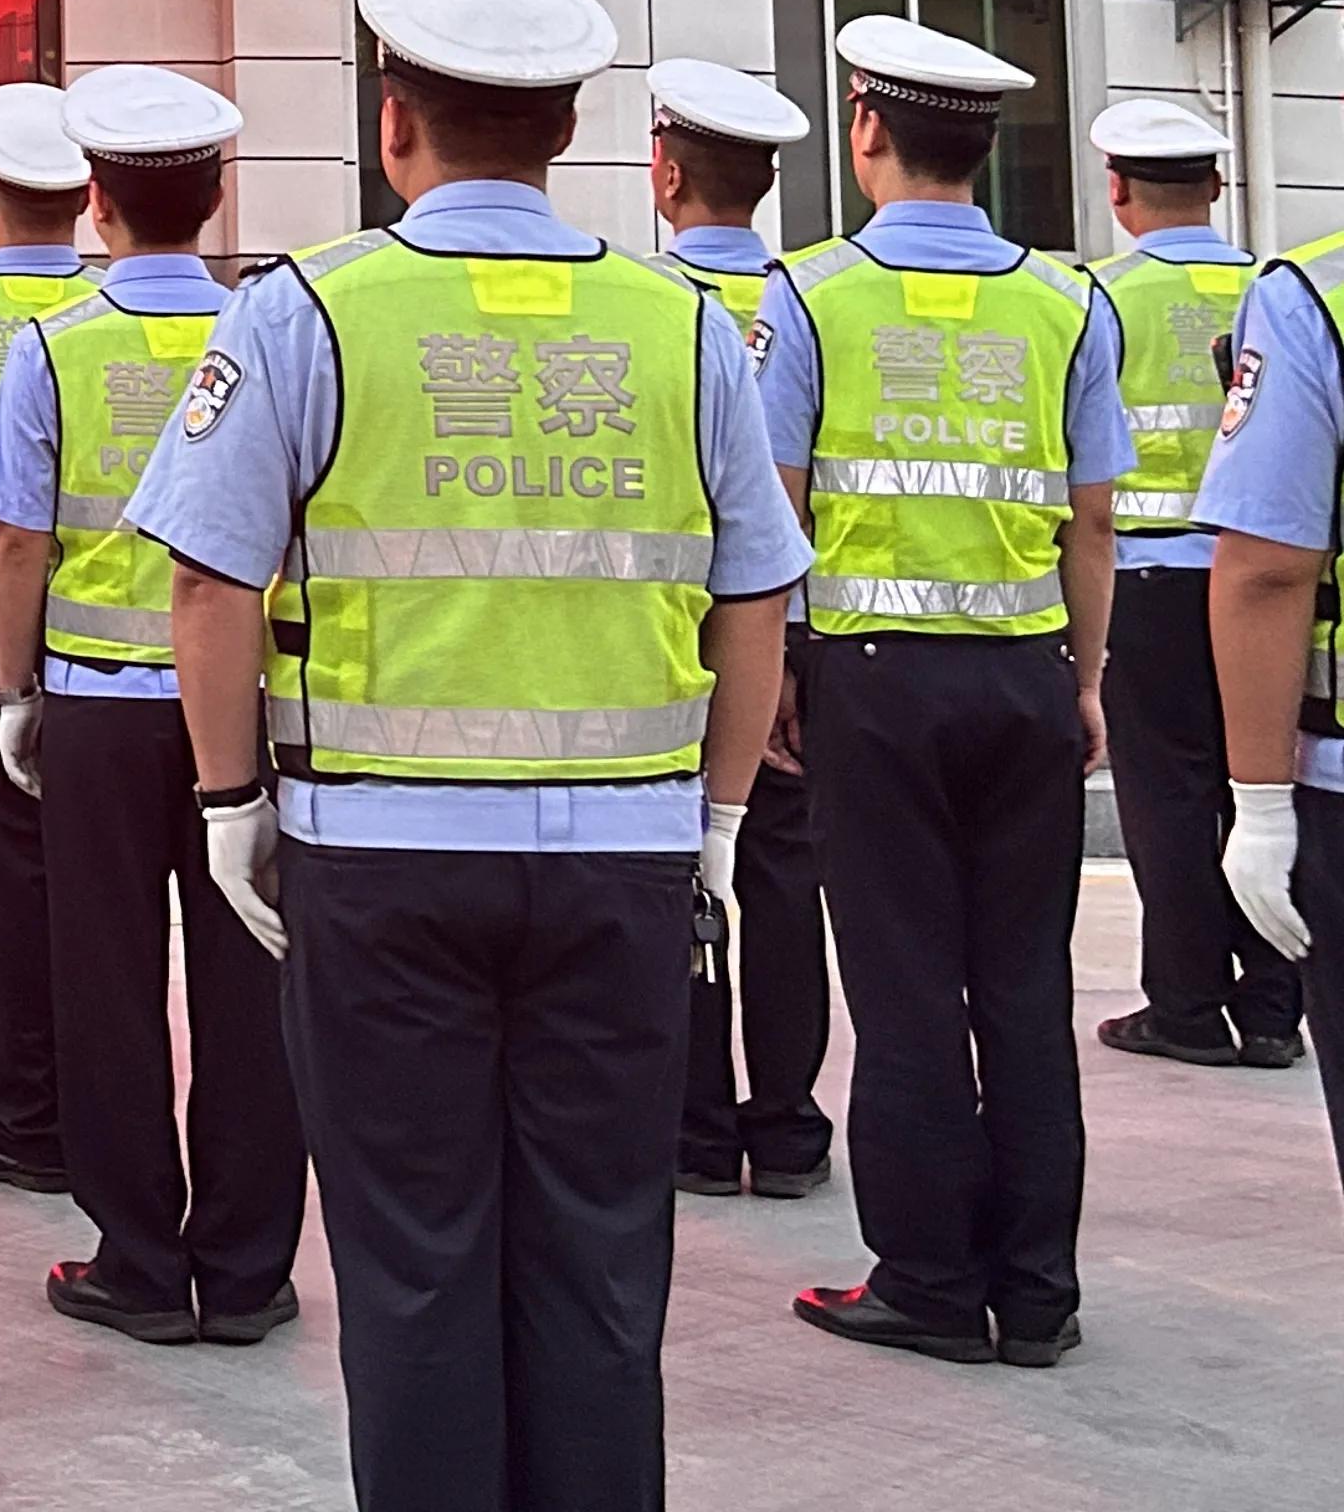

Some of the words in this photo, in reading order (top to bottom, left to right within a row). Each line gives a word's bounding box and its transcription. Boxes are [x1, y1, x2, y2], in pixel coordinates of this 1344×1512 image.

[418, 333, 637, 440] 警察
[871, 324, 1029, 405] 警察
[873, 413, 1028, 453] POLICE
[424, 455, 646, 500] POLICE
